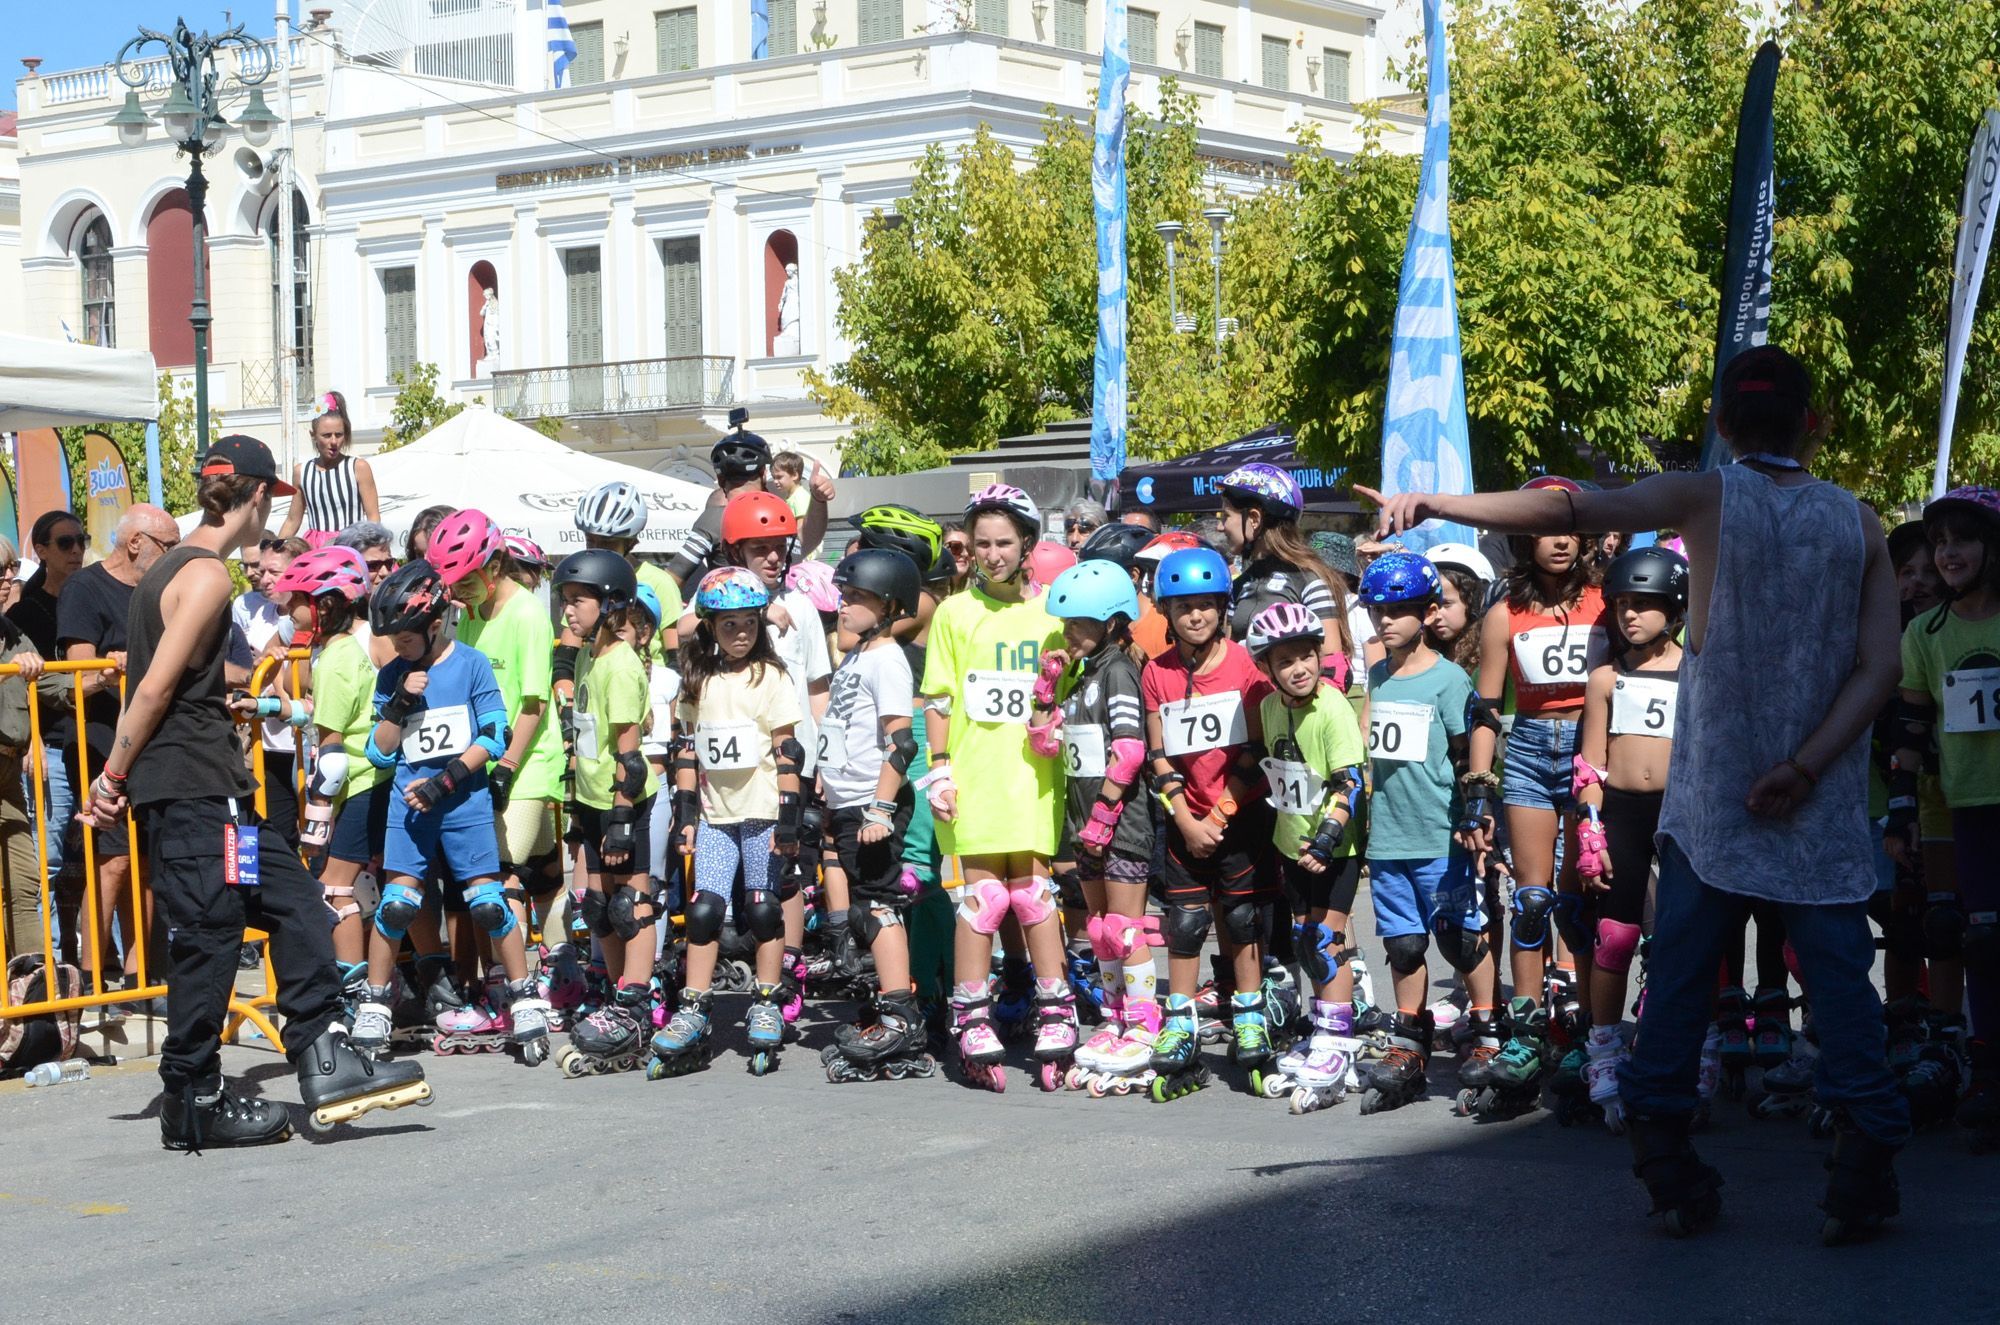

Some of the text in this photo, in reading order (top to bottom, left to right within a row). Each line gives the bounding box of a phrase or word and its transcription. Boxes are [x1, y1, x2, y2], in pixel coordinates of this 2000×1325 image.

[709, 144, 750, 164] BANK
[1542, 643, 1588, 676] 65
[985, 688, 1025, 718] 38
[1644, 697, 1667, 730] 5
[418, 723, 454, 754] 52
[1180, 713, 1222, 747] 79
[708, 735, 741, 764] 54
[1277, 777, 1303, 809] 21
[227, 827, 237, 881] ORGANIZER
